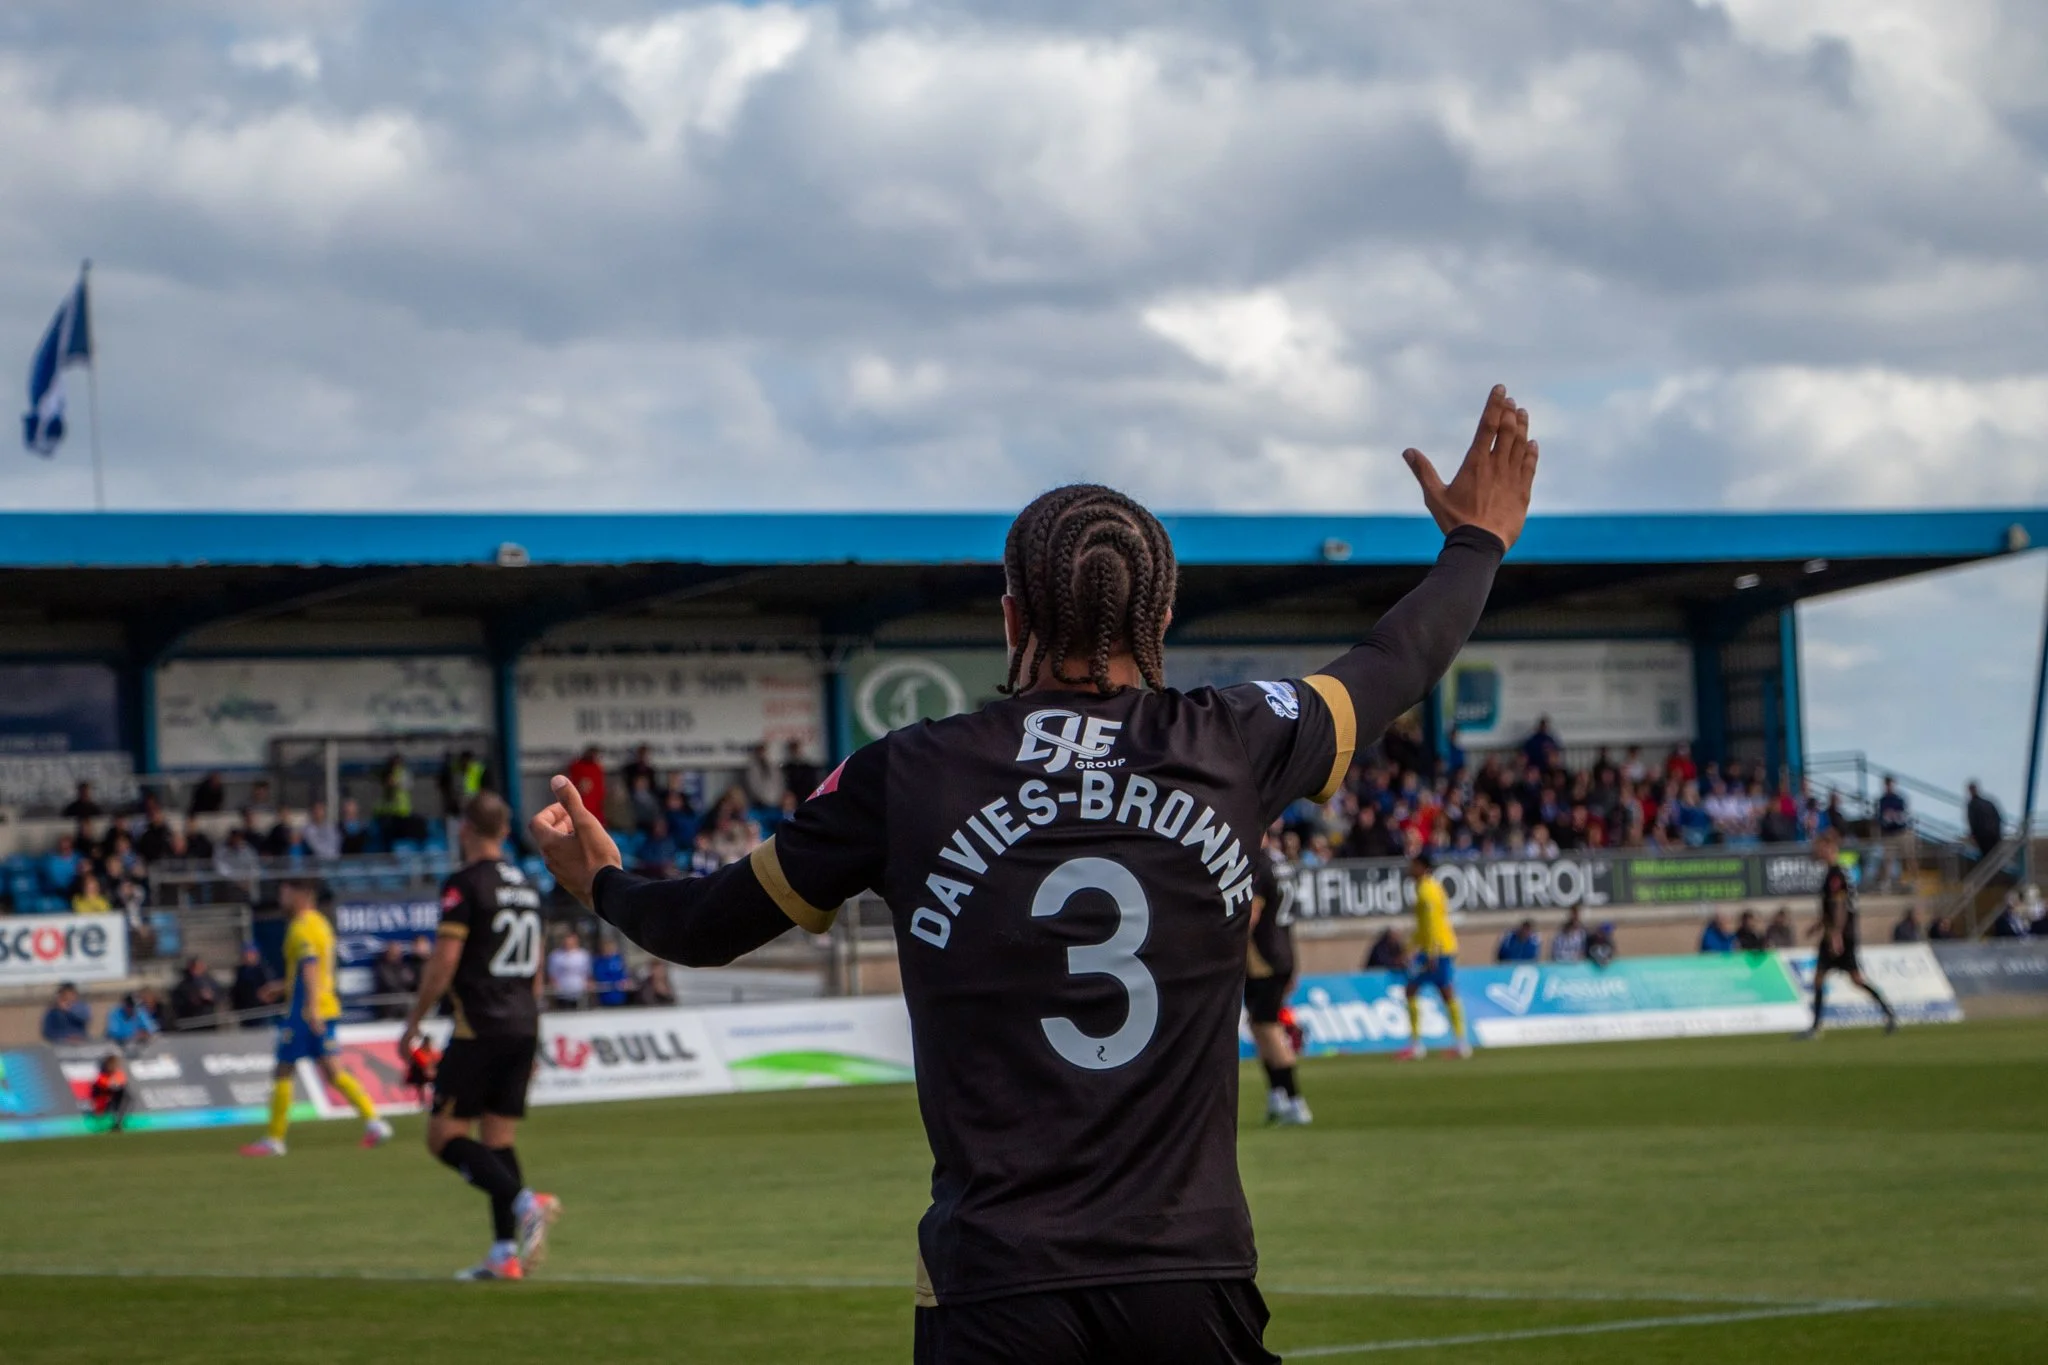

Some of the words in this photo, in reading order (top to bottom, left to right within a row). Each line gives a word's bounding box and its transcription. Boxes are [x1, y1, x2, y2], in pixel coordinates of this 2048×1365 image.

[1075, 758, 1126, 769] GROUP
[910, 770, 1254, 949] DAVIES-BROWNE
[489, 908, 541, 978] 20
[1031, 857, 1158, 1069] 3
